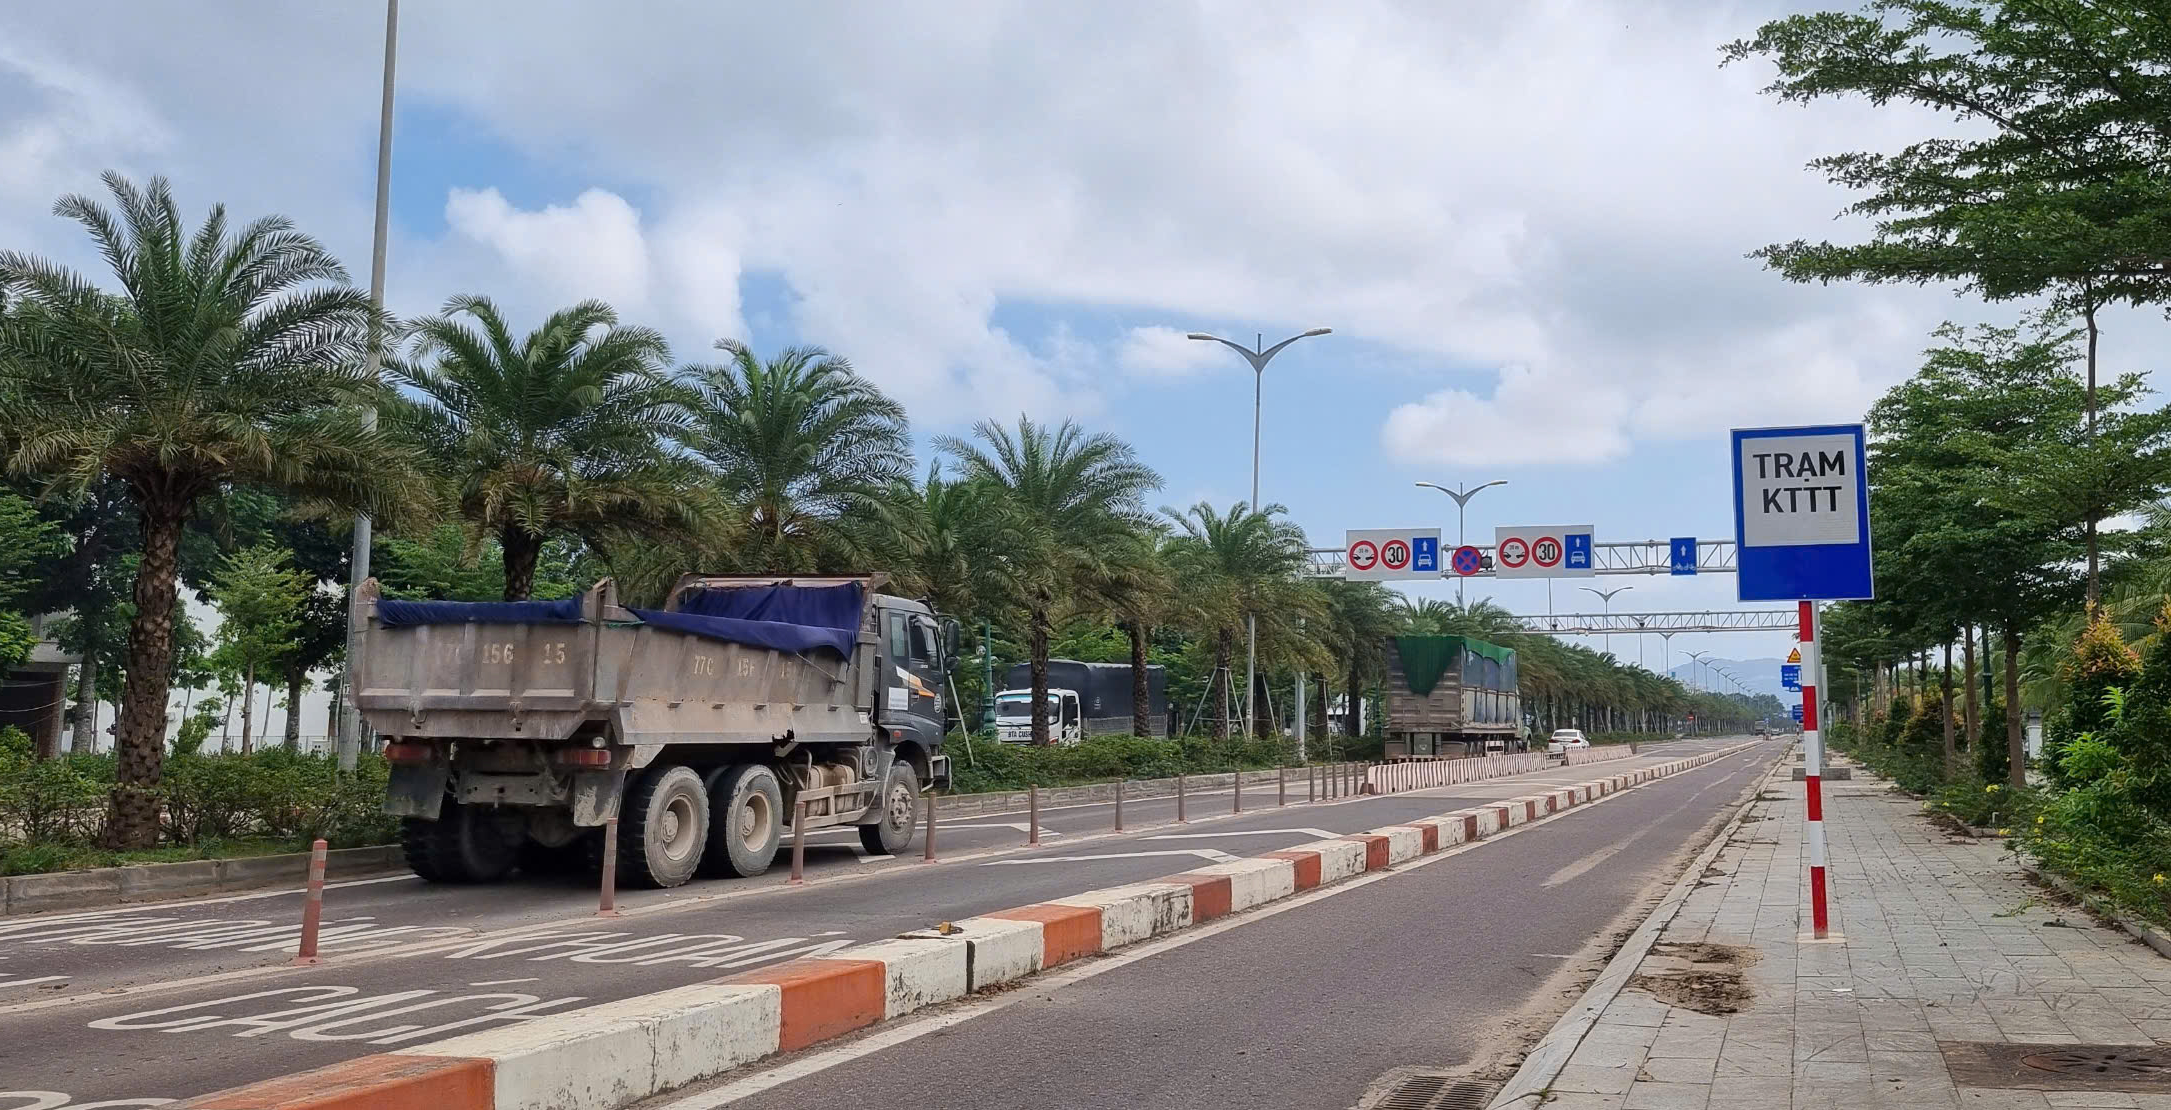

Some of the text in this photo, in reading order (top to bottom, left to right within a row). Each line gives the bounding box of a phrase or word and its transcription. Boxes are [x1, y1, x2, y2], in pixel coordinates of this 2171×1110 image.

[1752, 450, 1846, 482] TRẠM
[1762, 486, 1843, 514] KTTT
[1387, 546, 1405, 564] 30
[1538, 543, 1556, 561] 30
[542, 643, 565, 664] 15
[693, 655, 714, 676] 77C
